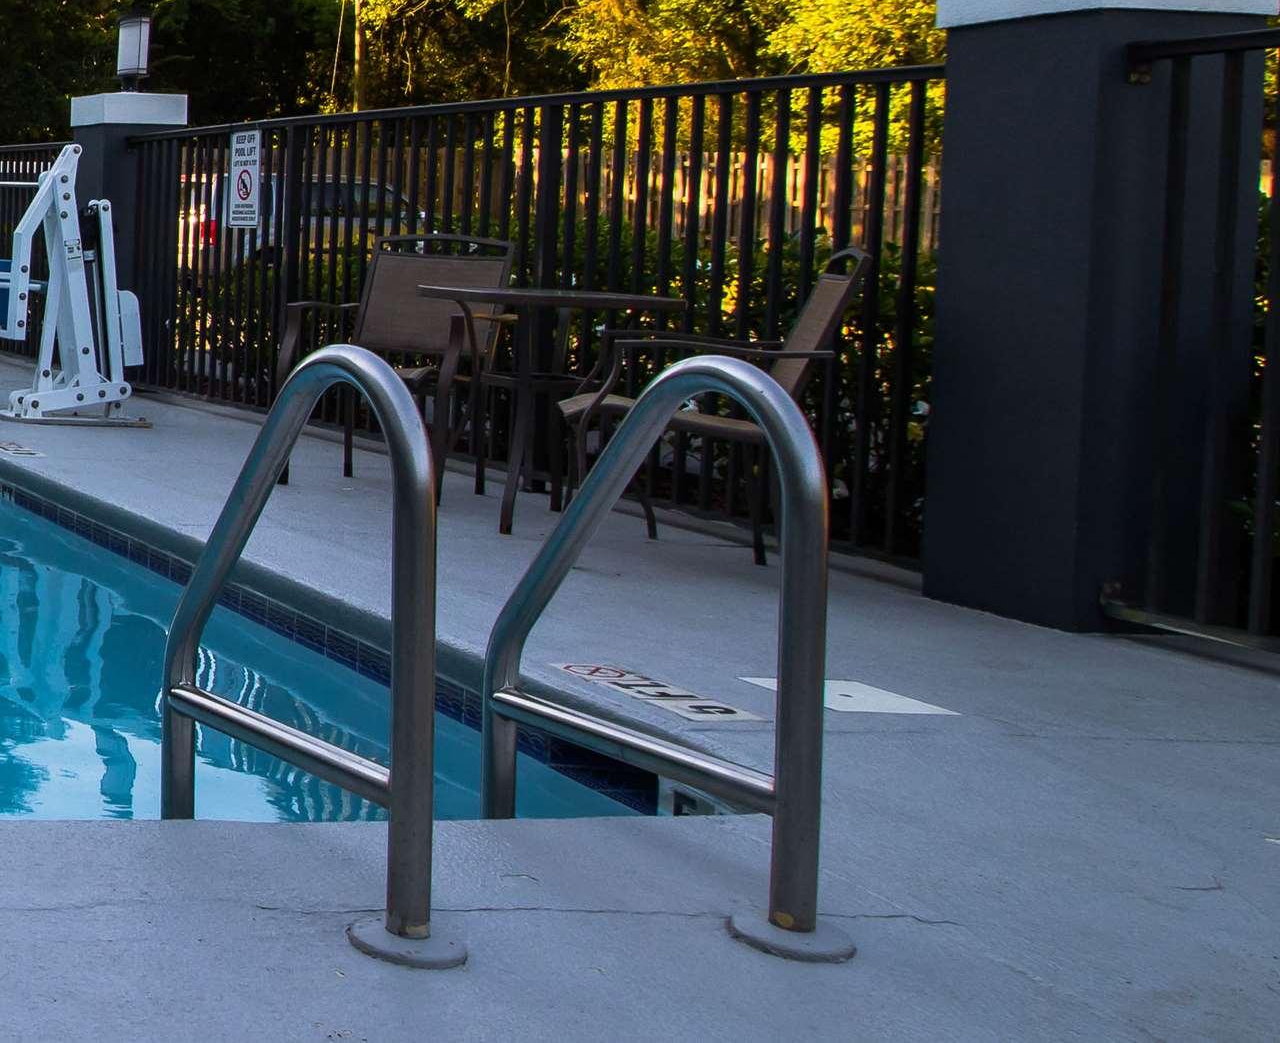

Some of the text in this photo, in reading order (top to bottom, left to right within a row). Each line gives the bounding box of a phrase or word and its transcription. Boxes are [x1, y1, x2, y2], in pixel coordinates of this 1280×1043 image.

[236, 134, 255, 144] KEEP OFF
[235, 147, 256, 156] POOL LIFT
[610, 681, 699, 698] FT
